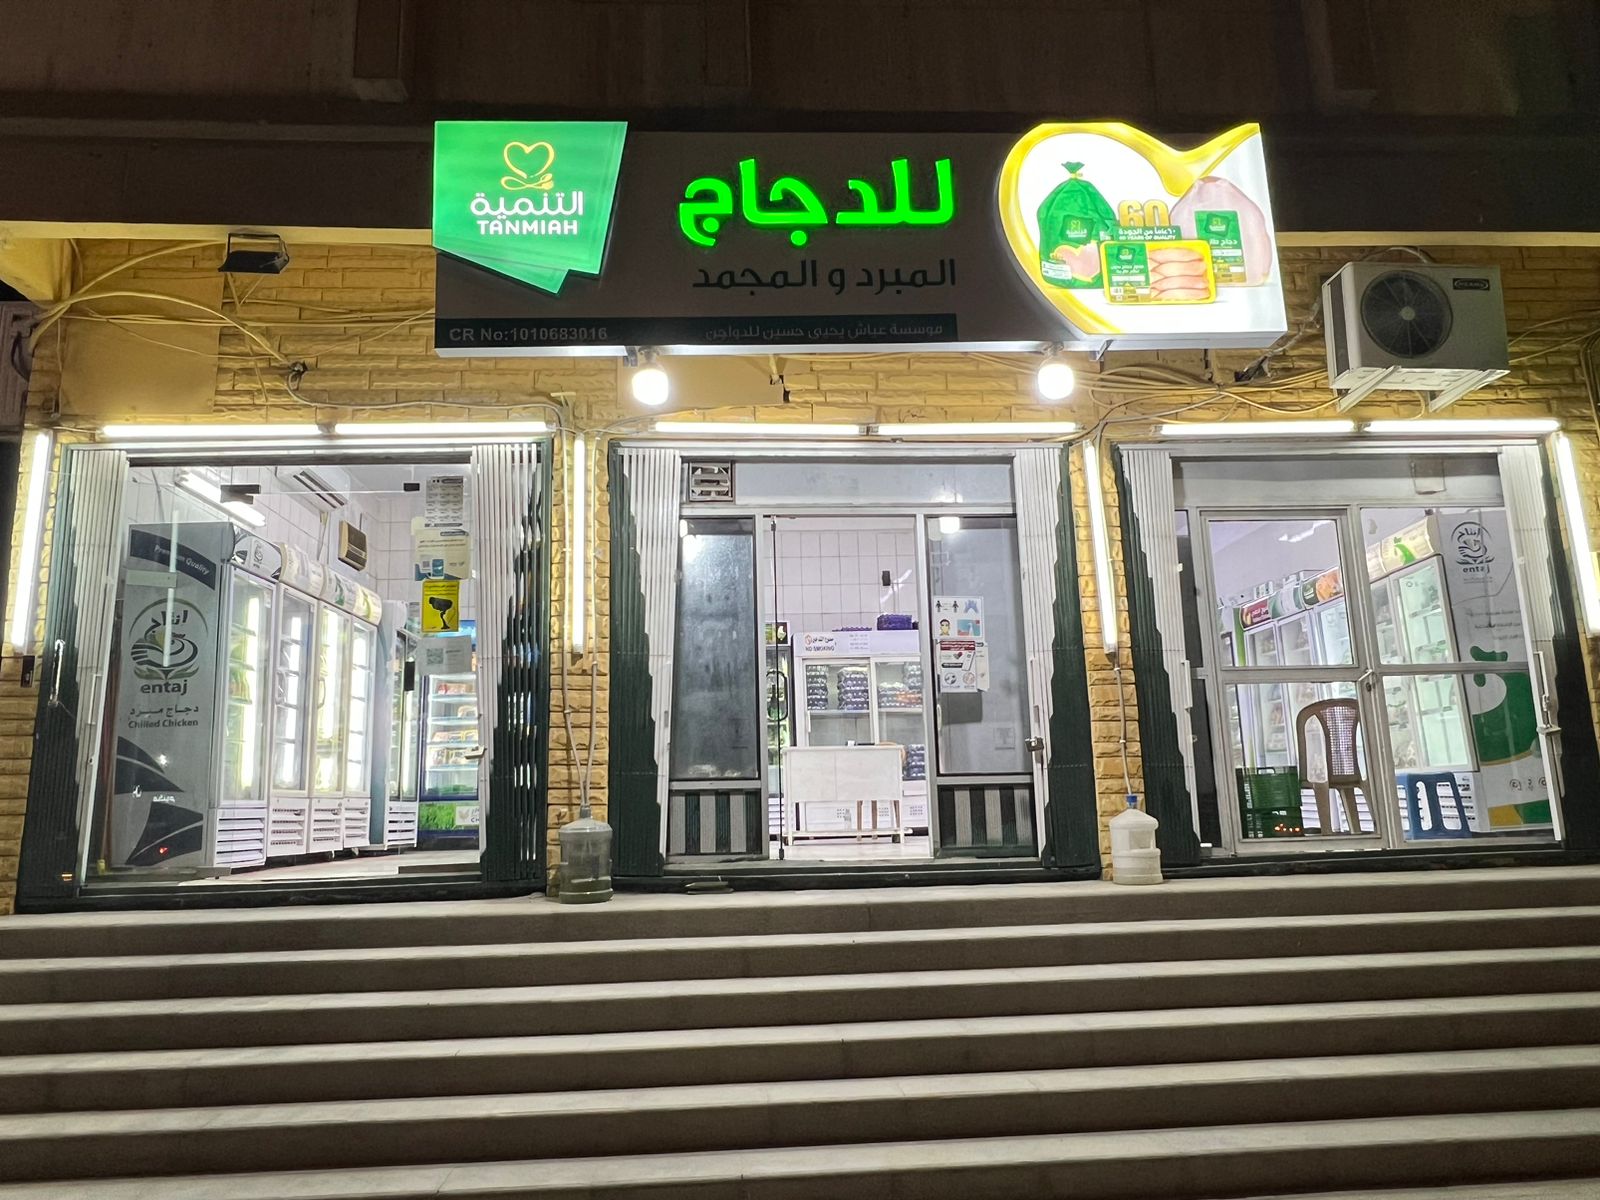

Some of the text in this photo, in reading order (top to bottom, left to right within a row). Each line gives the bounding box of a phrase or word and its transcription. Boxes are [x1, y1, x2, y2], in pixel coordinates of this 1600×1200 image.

[470, 191, 585, 220] التنمية
[679, 158, 954, 246] للدجاج
[1118, 199, 1169, 227] 60
[476, 219, 579, 236] TANMIAH
[693, 258, 956, 296] المبرد و المجمد
[449, 327, 475, 341] CR
[185, 557, 210, 575] Quality
[140, 680, 188, 696] entaj
[165, 704, 199, 718] دجاج
[128, 718, 199, 729] Chilled Chicken
